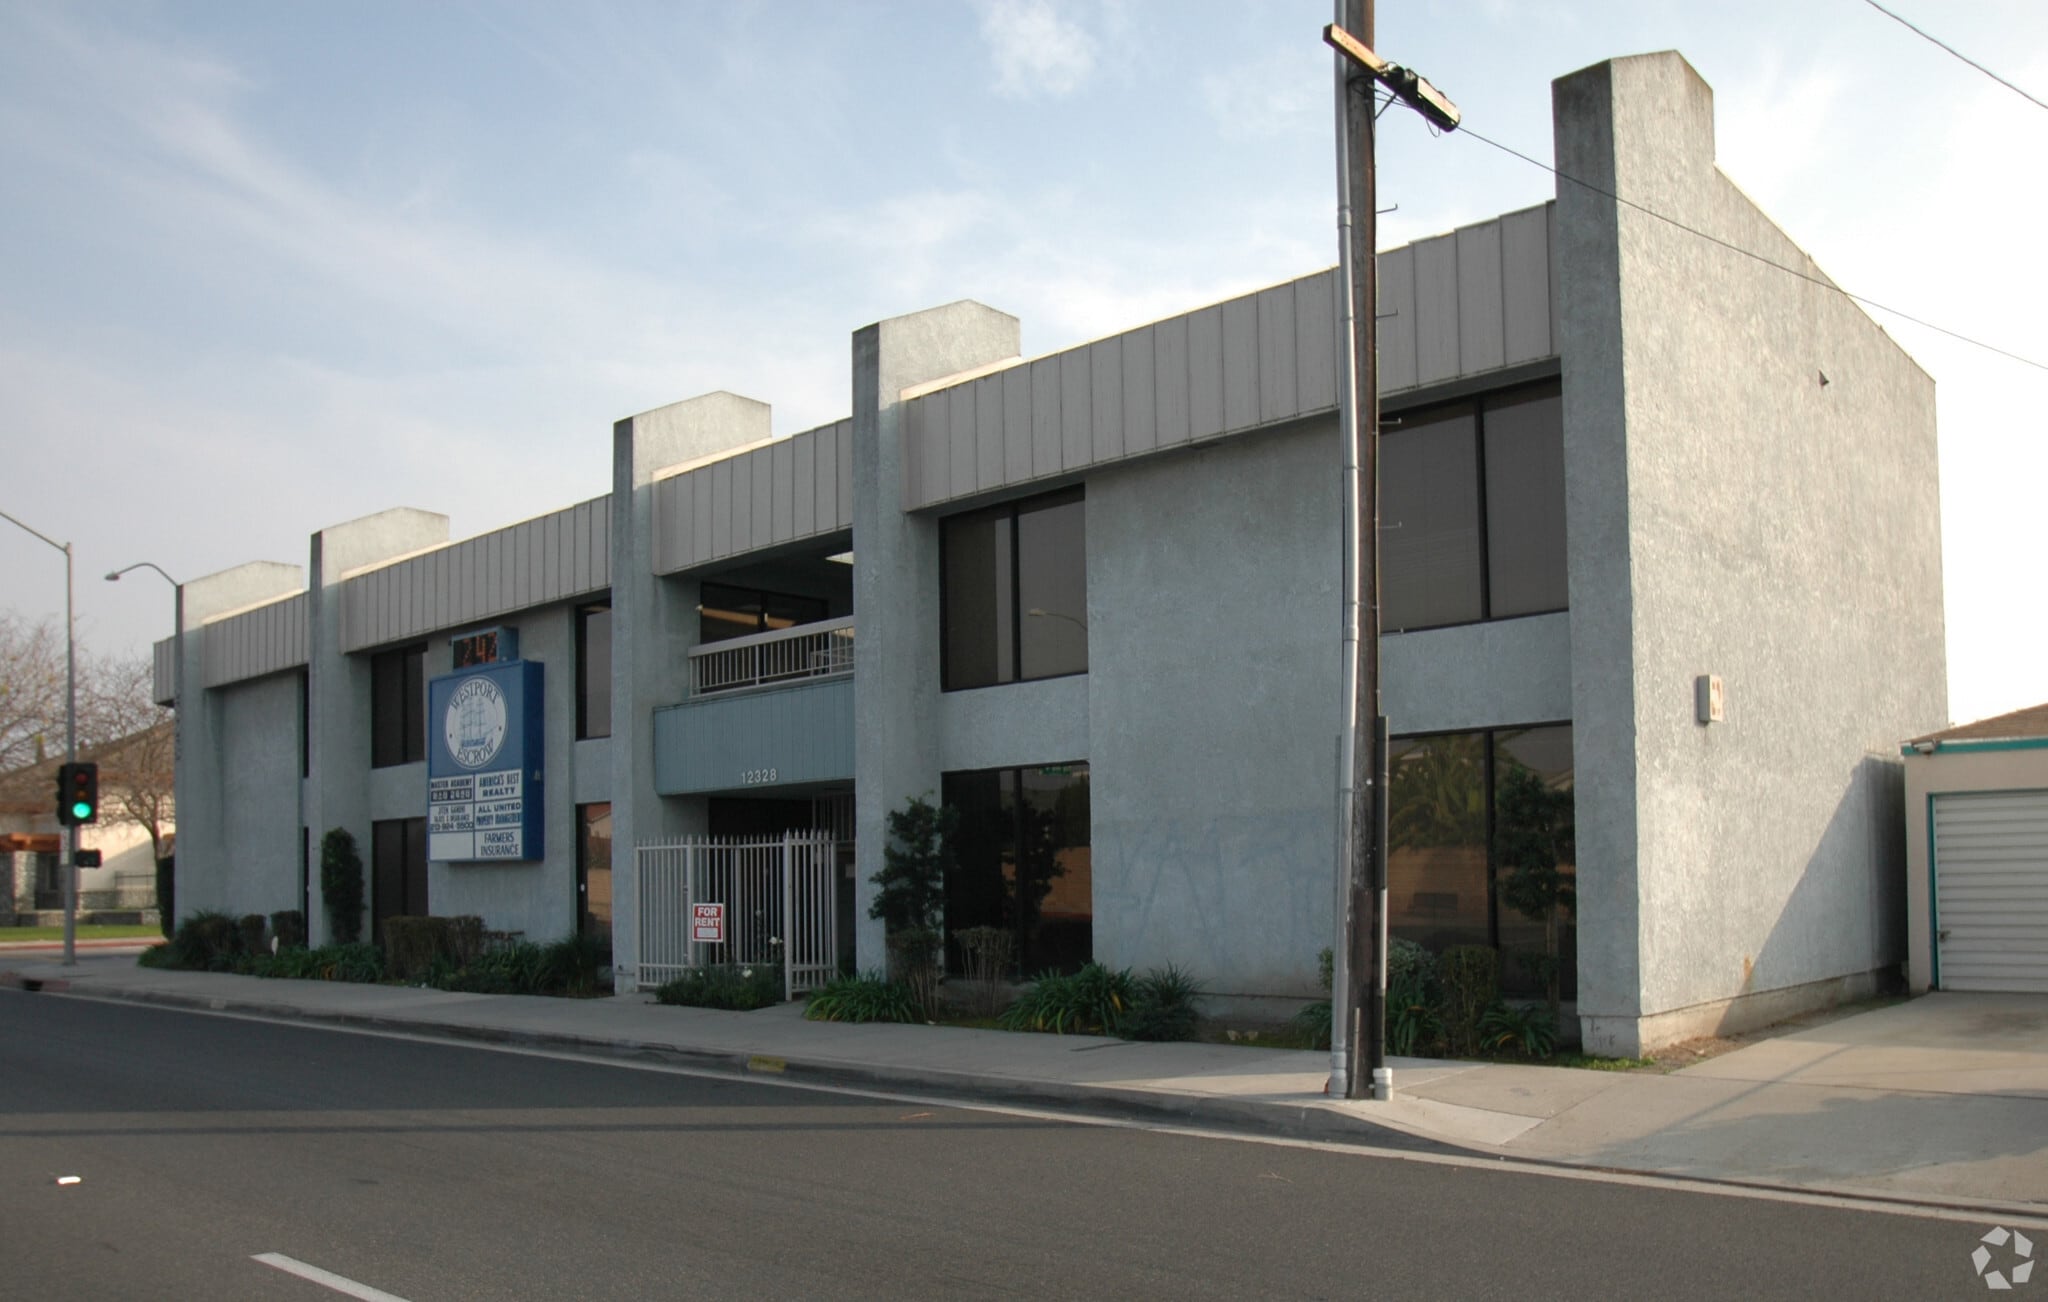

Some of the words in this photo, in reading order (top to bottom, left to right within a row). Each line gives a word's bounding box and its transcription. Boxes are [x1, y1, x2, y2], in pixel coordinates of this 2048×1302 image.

[451, 681, 499, 710] WESTPORT
[457, 738, 494, 764] ESCROW
[741, 768, 777, 784] 12328
[483, 786, 515, 797] REALTY
[478, 805, 492, 813] ALL
[494, 802, 521, 811] UNITED
[484, 832, 515, 843] FARMERS
[481, 843, 519, 857] INSURANCE
[697, 907, 718, 917] FOR
[694, 917, 720, 927] RENT
